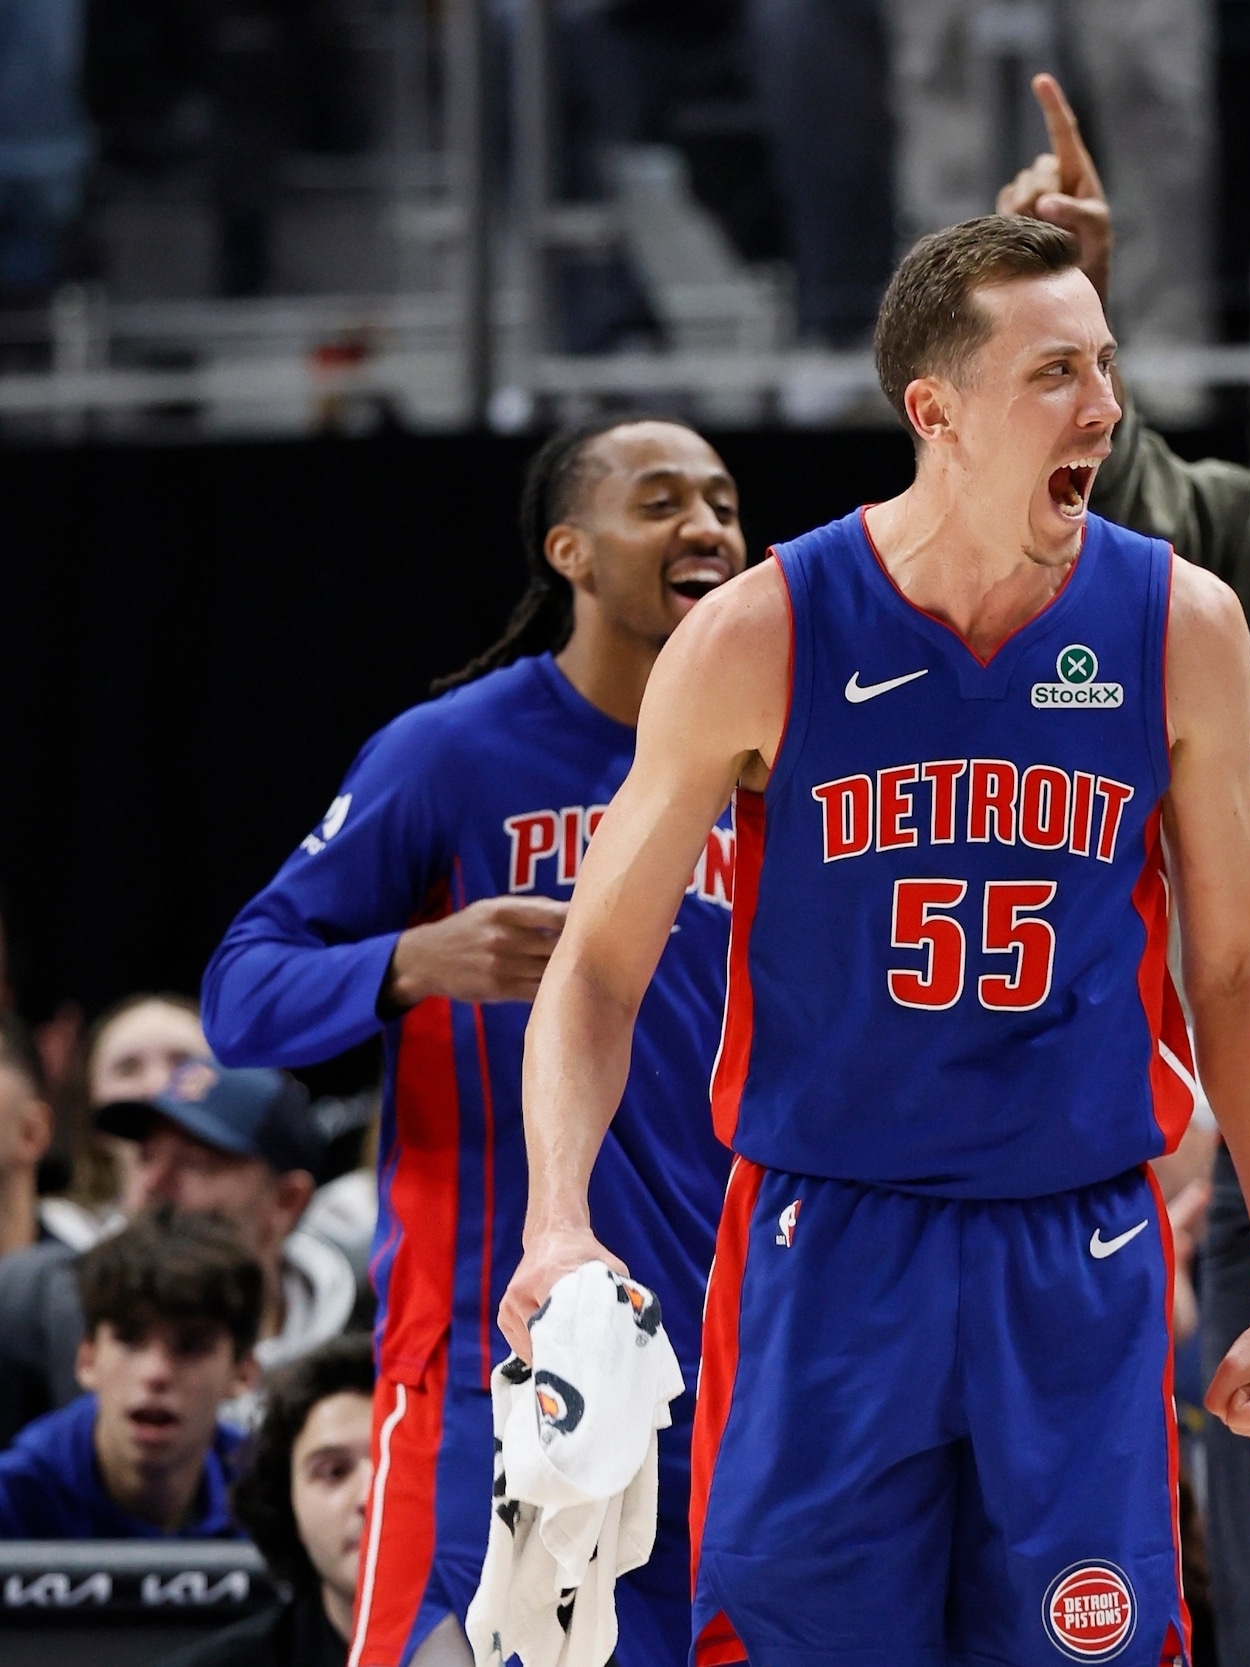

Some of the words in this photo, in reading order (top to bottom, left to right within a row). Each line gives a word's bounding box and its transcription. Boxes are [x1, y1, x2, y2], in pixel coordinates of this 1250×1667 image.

[1034, 686, 1119, 704] StockX
[811, 759, 1135, 864] DETROIT
[887, 878, 1058, 1012] 55
[1063, 1591, 1120, 1613] DETROIT
[1064, 1608, 1122, 1629] PISTONS
